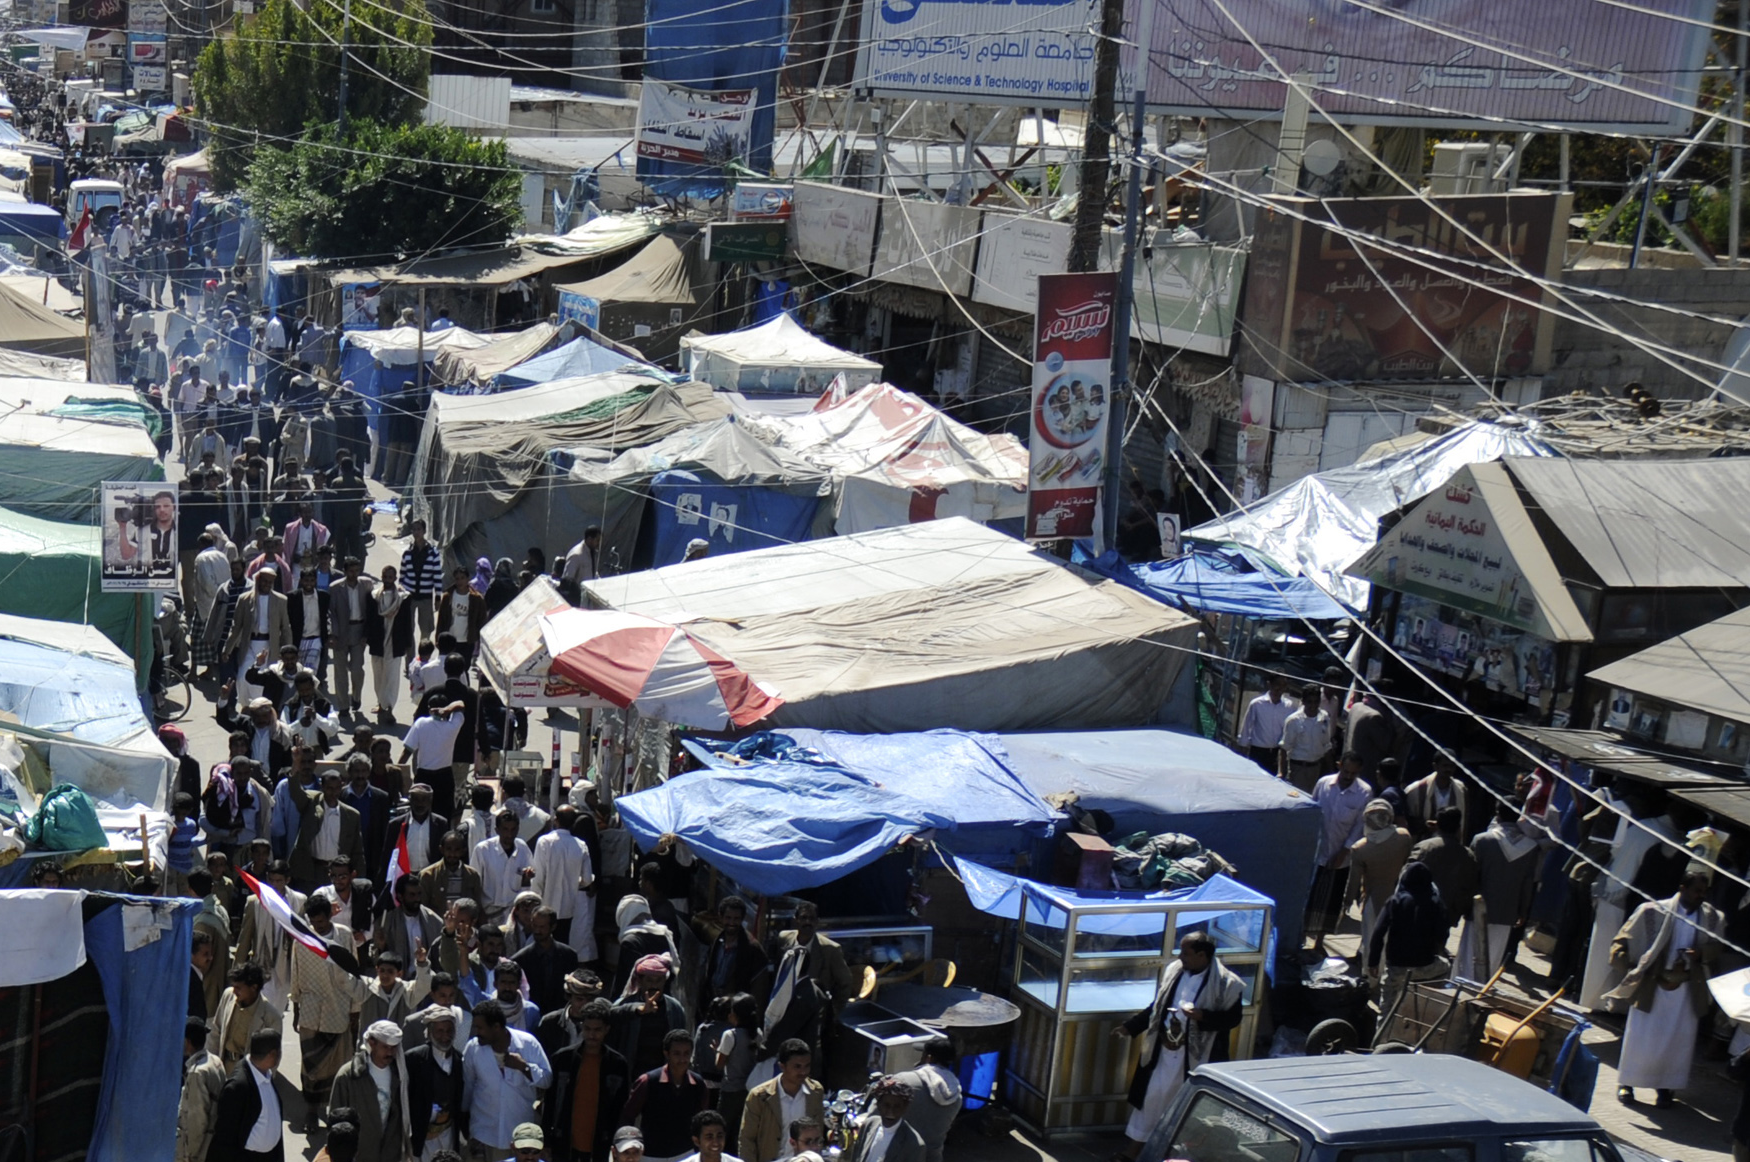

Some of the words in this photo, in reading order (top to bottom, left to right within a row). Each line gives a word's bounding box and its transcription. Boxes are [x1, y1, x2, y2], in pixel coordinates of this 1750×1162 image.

[877, 32, 971, 60] والتكنولوجيا
[976, 37, 1029, 63] العلوم
[874, 69, 919, 86] University
[920, 71, 932, 84] of
[933, 72, 971, 87] Science
[973, 74, 982, 86] &
[985, 74, 1045, 94] Technology
[1046, 78, 1090, 95] Hospital
[1405, 45, 1624, 104] مرضاكم
[1324, 273, 1372, 294] والبخور
[148, 565, 174, 578] حسن
